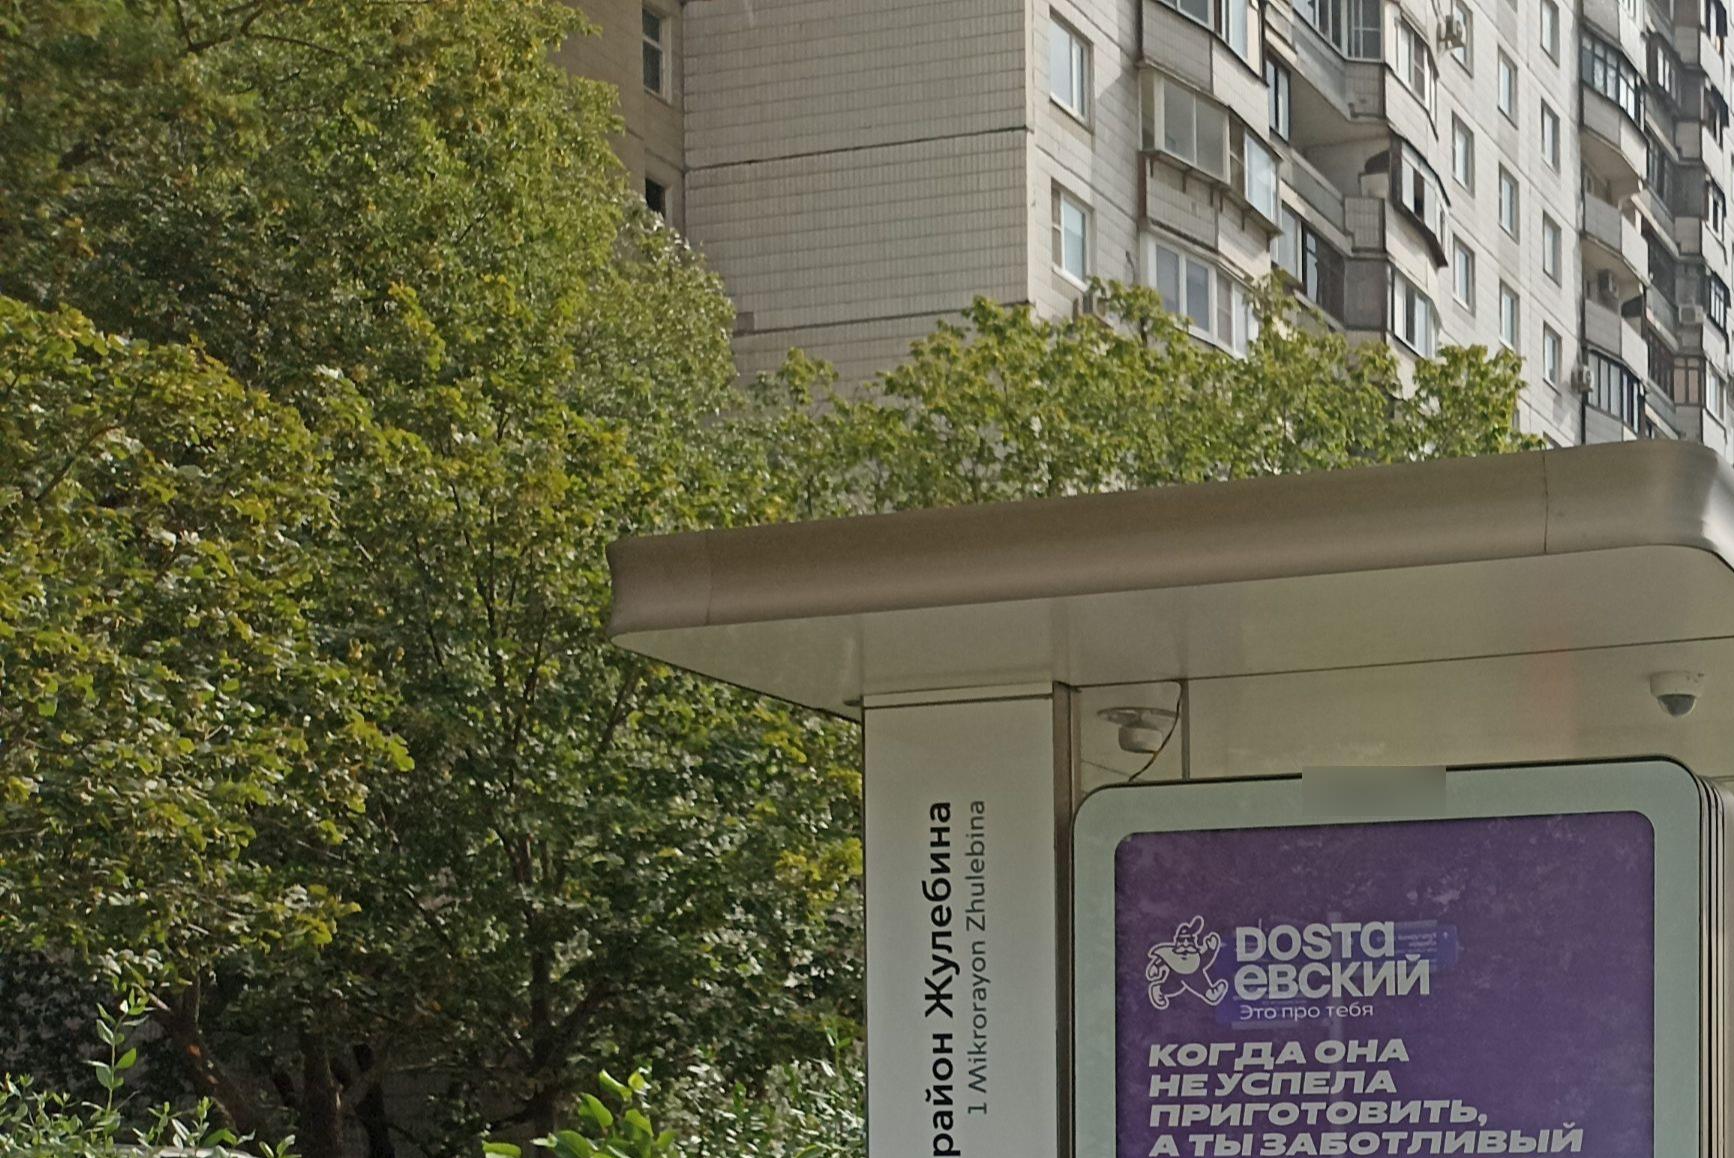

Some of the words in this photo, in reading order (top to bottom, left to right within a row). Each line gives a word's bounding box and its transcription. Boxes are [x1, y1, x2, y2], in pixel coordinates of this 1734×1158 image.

[964, 799, 986, 932] Zhulebina
[920, 800, 961, 1019] Жулебина
[965, 941, 992, 1095] Mikrorayon
[1240, 1006, 1277, 1020] Это
[1281, 1005, 1320, 1022] про
[1327, 1002, 1374, 1018] тебя
[1149, 1041, 1307, 1072] КОГДА
[1314, 1038, 1410, 1064] ОНА
[1149, 1073, 1209, 1098] НЕ
[1214, 1070, 1398, 1097] УСПЕЛА
[967, 1102, 988, 1116] 1
[1149, 1099, 1488, 1128] ПРИГОТОВИТЬ,
[1149, 1134, 1180, 1158] А
[1188, 1133, 1254, 1158] ТЫ
[1259, 1121, 1584, 1157] ЗАБОТЛИВЫЙ
